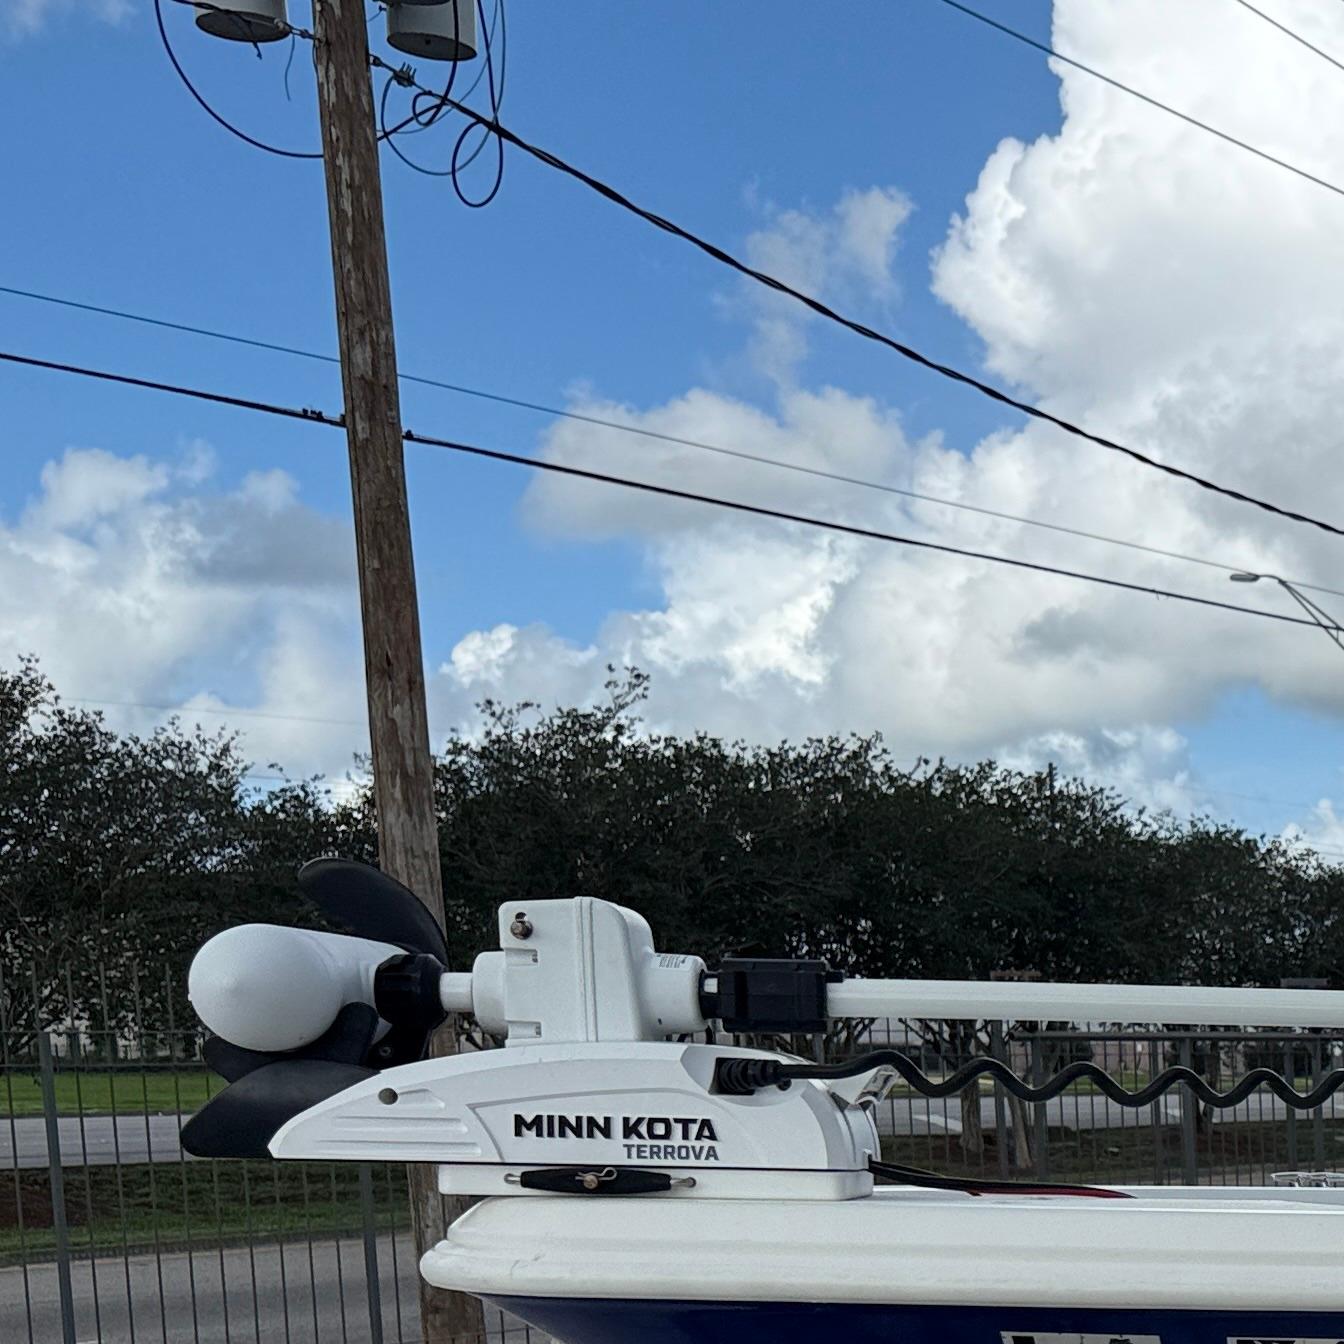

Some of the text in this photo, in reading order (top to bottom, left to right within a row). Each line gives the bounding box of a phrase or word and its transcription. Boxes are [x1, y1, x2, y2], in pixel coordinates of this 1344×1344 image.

[514, 1114, 719, 1141] MINN KOTA
[622, 1144, 720, 1161] TERROVA
